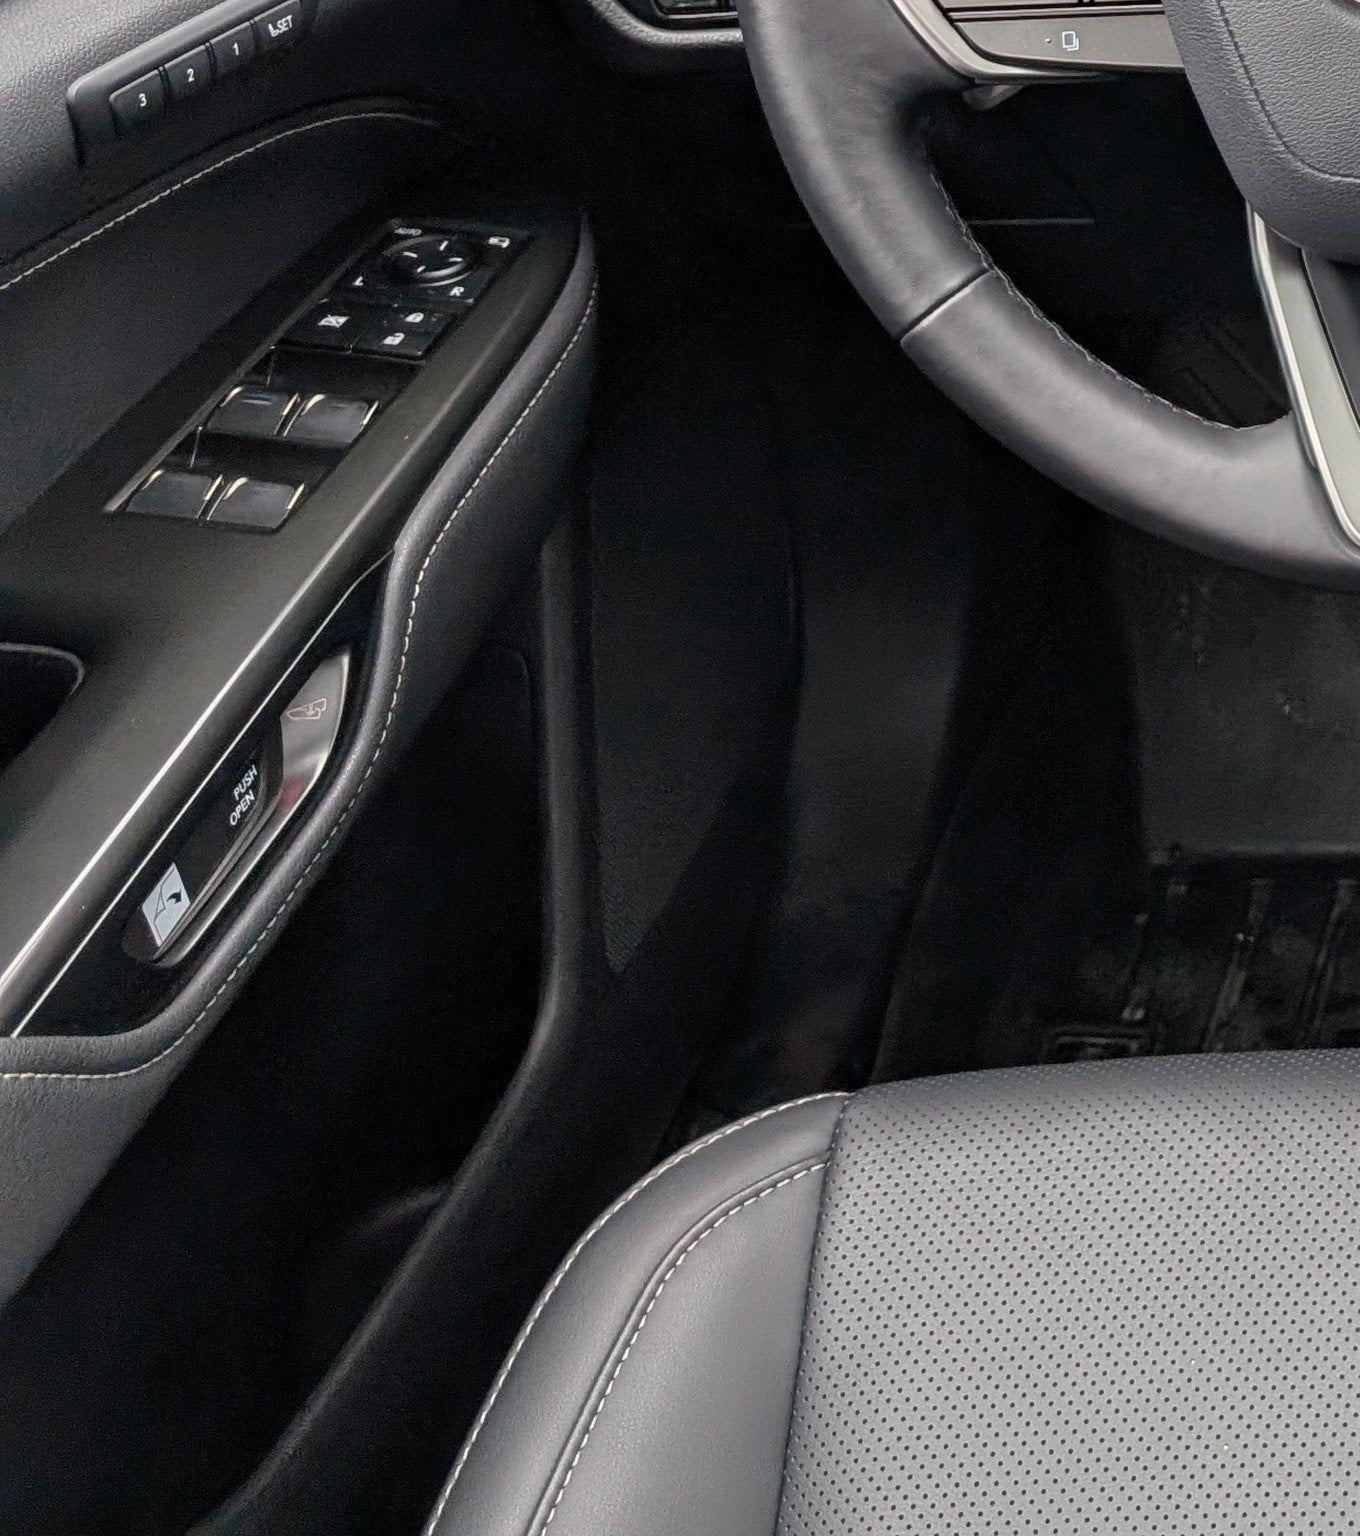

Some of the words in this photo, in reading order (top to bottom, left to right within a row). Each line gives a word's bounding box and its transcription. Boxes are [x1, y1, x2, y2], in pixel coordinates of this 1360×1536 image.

[277, 15, 293, 34] SET
[232, 42, 240, 56] 1
[186, 68, 195, 82] 2
[138, 93, 147, 107] 3
[233, 764, 258, 801] PUSH
[230, 789, 255, 826] OPEN
